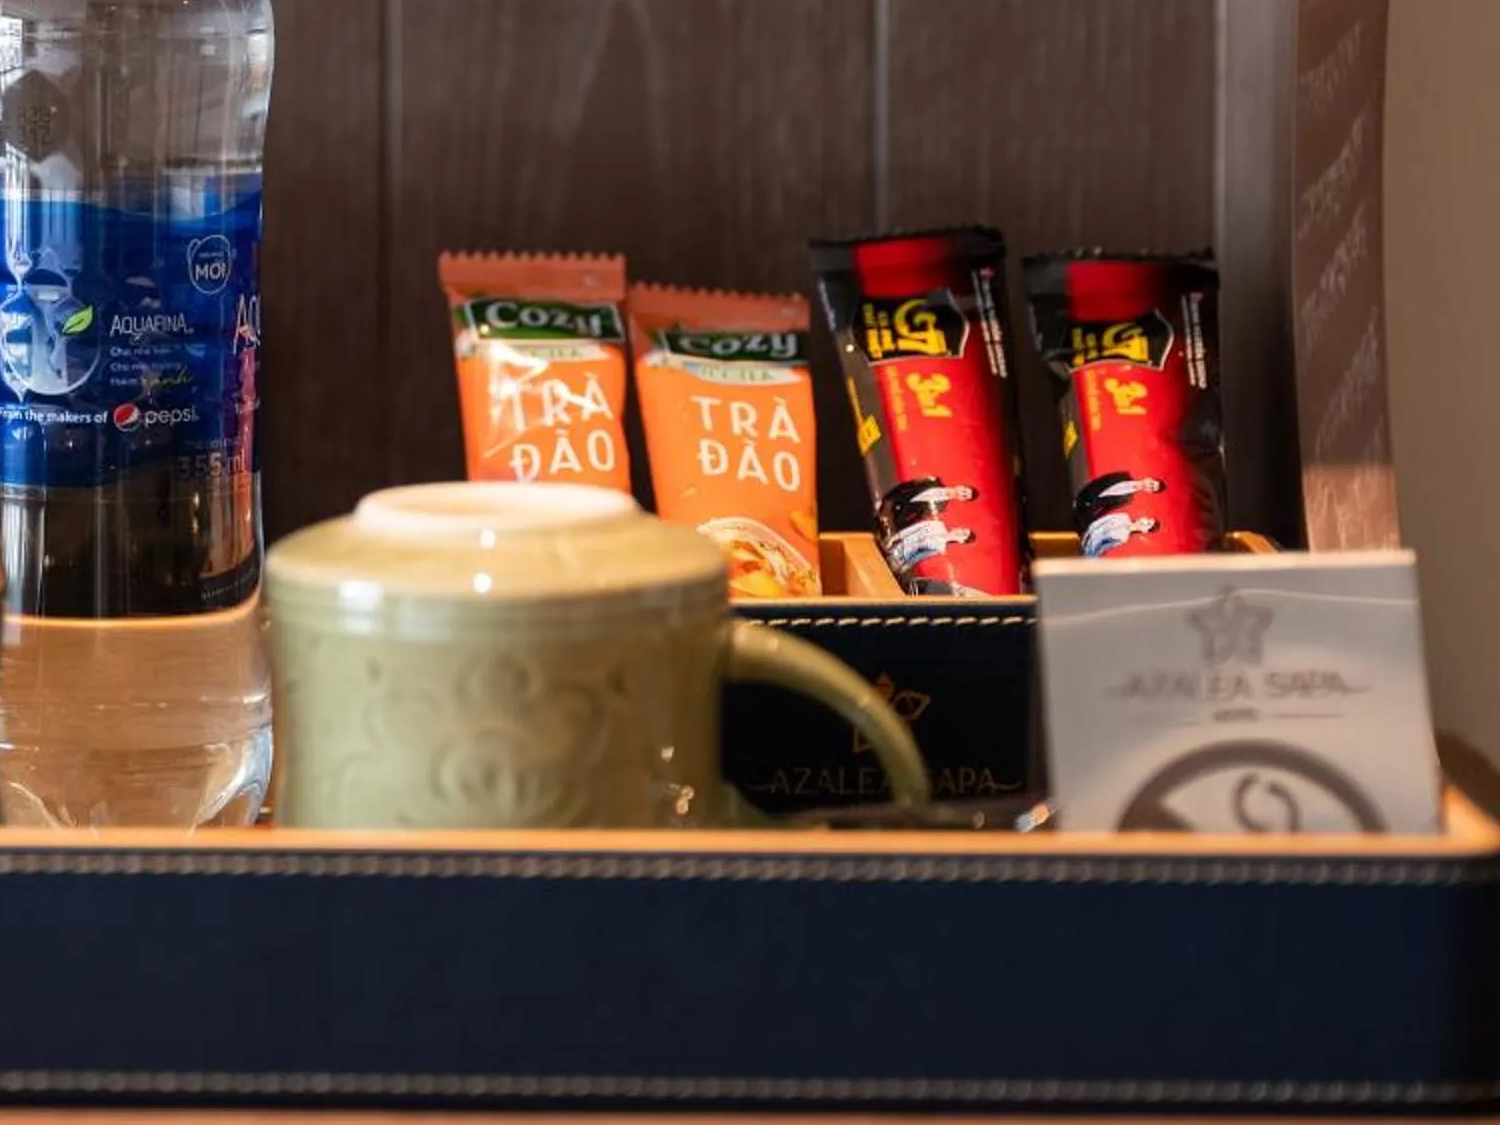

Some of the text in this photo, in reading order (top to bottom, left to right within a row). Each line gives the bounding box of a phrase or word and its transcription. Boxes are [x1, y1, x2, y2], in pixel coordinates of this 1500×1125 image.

[109, 312, 188, 337] AQUAFINA
[25, 409, 45, 422] the
[47, 411, 92, 424] makers
[93, 410, 109, 424] of
[144, 405, 197, 428] pepsi
[690, 394, 801, 444] TRÀ
[696, 437, 801, 493] ĐÀO
[932, 767, 1023, 795] APA
